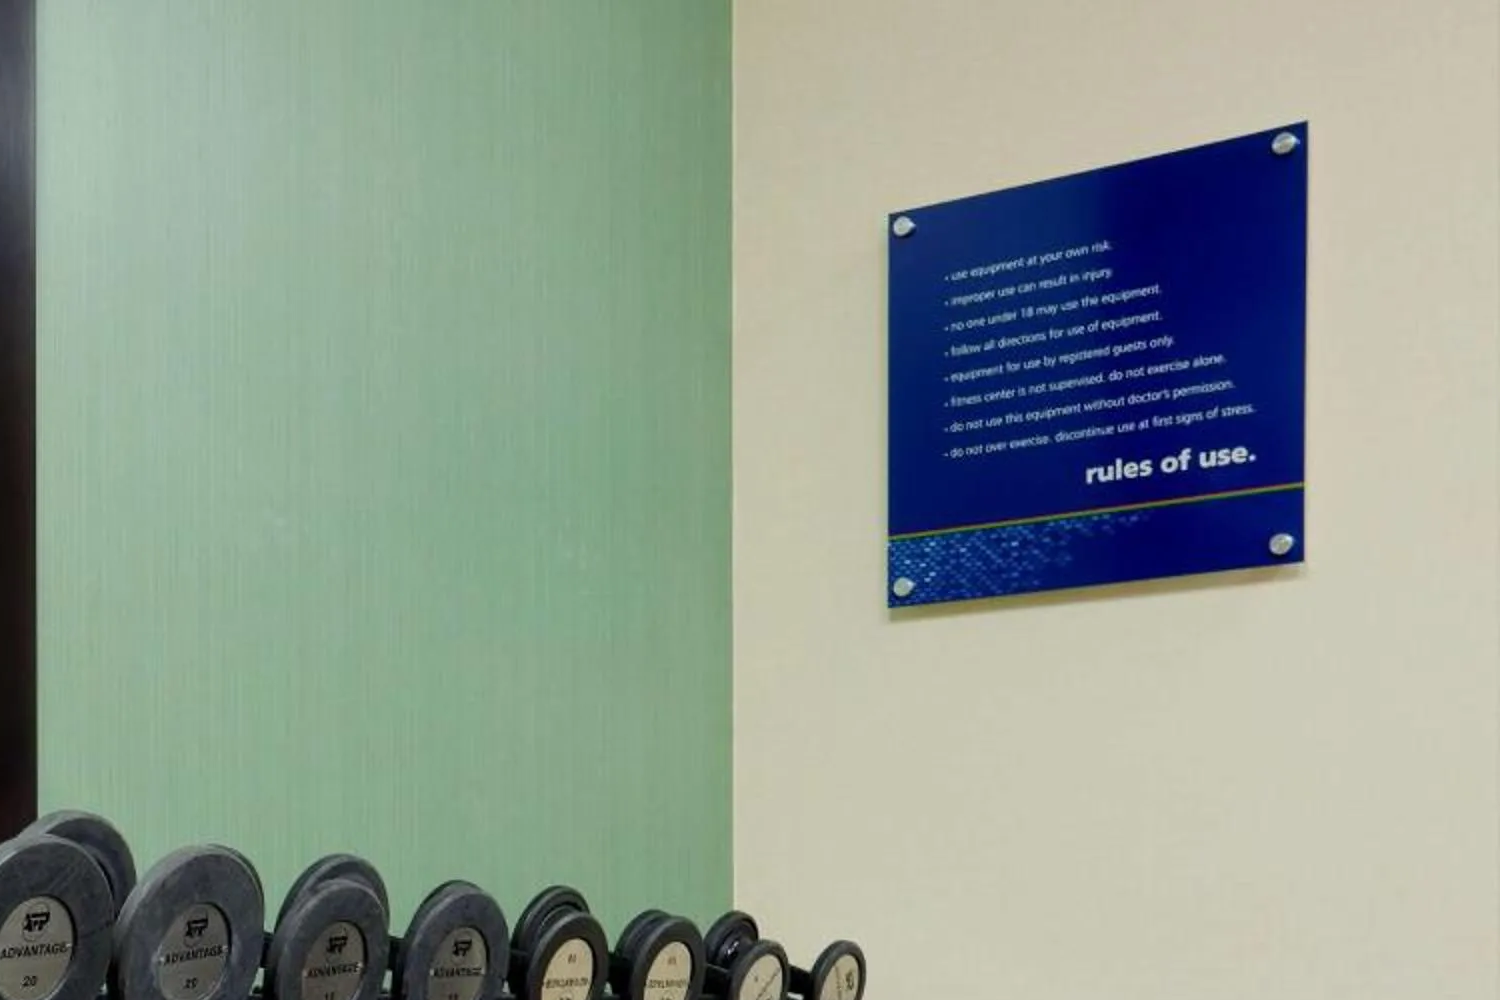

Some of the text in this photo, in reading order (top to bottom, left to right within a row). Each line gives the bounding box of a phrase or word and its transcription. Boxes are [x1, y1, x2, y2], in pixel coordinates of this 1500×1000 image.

[951, 270, 968, 281] use
[970, 257, 1024, 277] equipment
[1025, 255, 1038, 266] at
[1039, 251, 1064, 266] your
[1065, 247, 1089, 259] own
[951, 289, 995, 306] improper
[997, 286, 1016, 298] use
[1017, 281, 1037, 293] can
[1038, 276, 1067, 290] result
[1069, 273, 1080, 284] in
[951, 321, 965, 332] no
[966, 316, 986, 328] one
[987, 311, 1017, 325] under
[1020, 306, 1034, 319] 18
[1036, 303, 1059, 317] may
[1060, 300, 1079, 311] use
[1081, 295, 1099, 308] the
[951, 341, 981, 357] follow
[984, 338, 995, 351] all
[997, 331, 1047, 349] directions
[1049, 327, 1064, 340] for
[1066, 324, 1085, 336] use
[1087, 320, 1099, 332] of
[951, 363, 1004, 383] equipment
[1005, 360, 1021, 372] for
[1023, 358, 1041, 370] use
[1042, 355, 1057, 369] by
[1059, 345, 1110, 365] registered
[1112, 339, 1148, 357] guests
[951, 393, 983, 408] fitness
[984, 388, 1016, 403] center
[1017, 385, 1027, 397] is
[1028, 382, 1047, 395] not
[1108, 369, 1123, 382] do
[1125, 366, 1145, 378] not
[1147, 358, 1190, 375] exercise
[950, 421, 965, 433] do
[966, 418, 984, 431] not
[985, 416, 1003, 428] use
[1005, 411, 1024, 424] this
[1025, 403, 1082, 422] equipment
[1084, 396, 1125, 412] without
[950, 446, 965, 459] do
[966, 443, 984, 456] not
[985, 440, 1007, 453] over
[1054, 424, 1115, 443] discontinue
[1117, 421, 1136, 433] use
[1138, 418, 1149, 430] at
[1152, 414, 1174, 428] first
[1175, 409, 1204, 426] signs
[1206, 406, 1219, 419] of
[1085, 446, 1256, 485] rules of use.
[0, 942, 67, 960] ADVANTAGE
[164, 945, 223, 965] ADVANTAGE
[22, 976, 37, 987] 20
